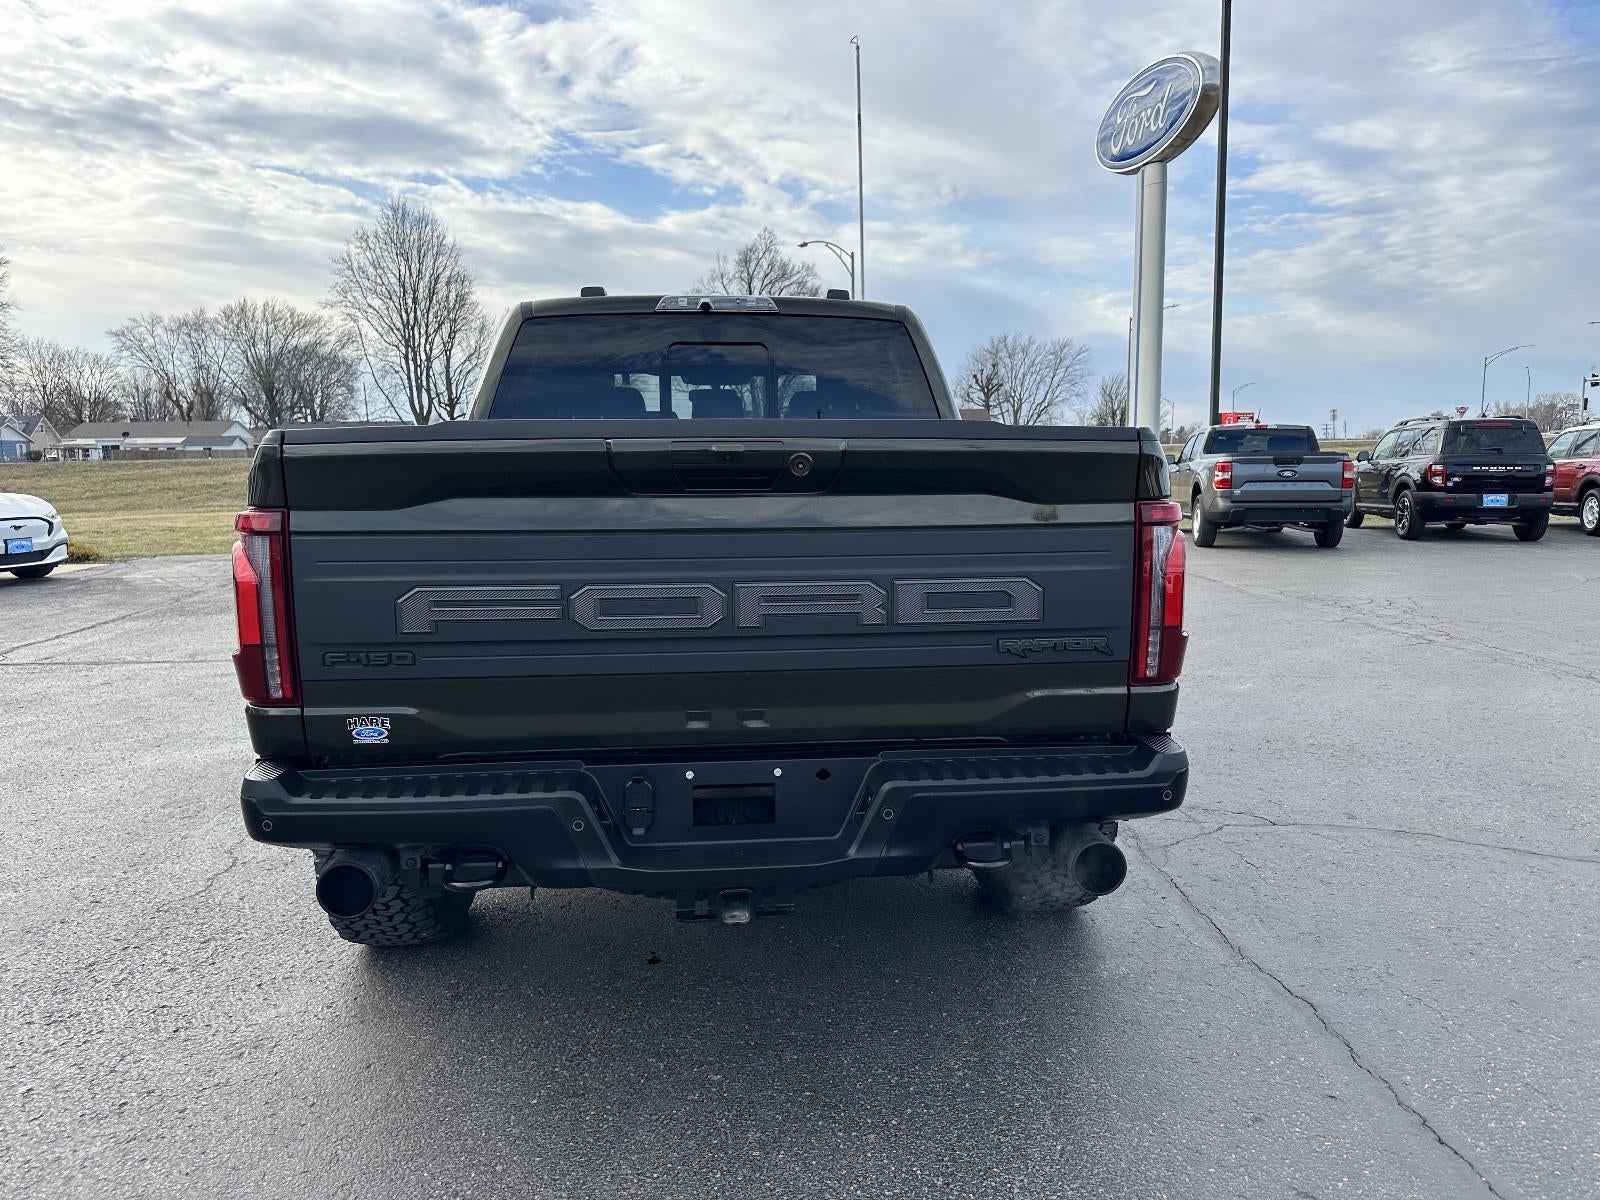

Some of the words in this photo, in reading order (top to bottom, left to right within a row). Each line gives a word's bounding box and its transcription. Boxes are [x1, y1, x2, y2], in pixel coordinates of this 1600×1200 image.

[1111, 80, 1173, 155] Ford
[395, 576, 1045, 634] FORD
[997, 635, 1114, 658] RAPTOR
[322, 650, 416, 667] F-150
[347, 716, 391, 731] HARE
[360, 729, 379, 738] Ford
